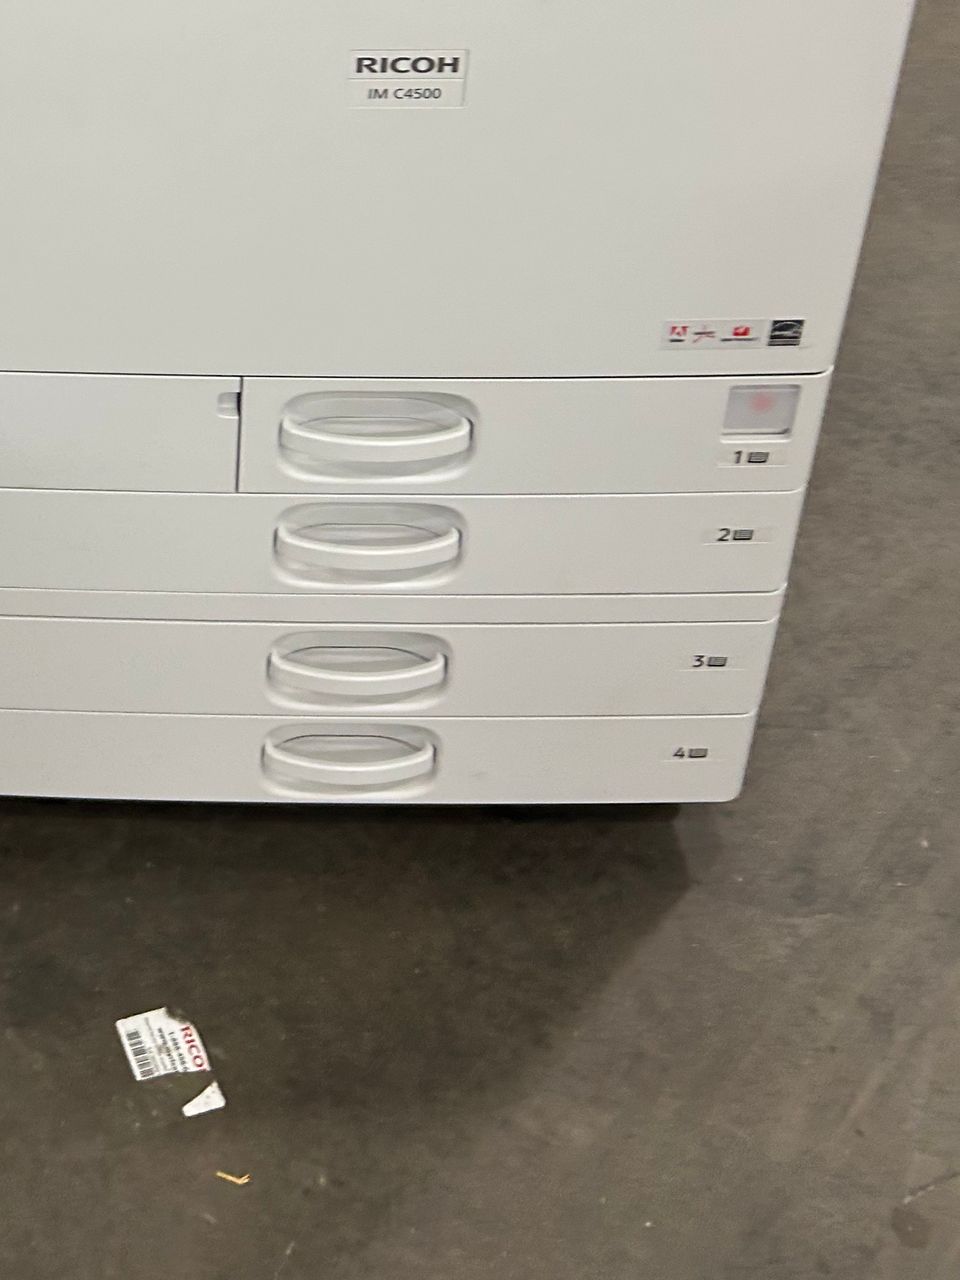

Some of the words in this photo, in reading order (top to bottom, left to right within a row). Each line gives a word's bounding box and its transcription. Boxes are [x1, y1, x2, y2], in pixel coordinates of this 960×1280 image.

[356, 56, 460, 73] RICOH
[367, 88, 389, 100] IM
[393, 88, 442, 100] C4500
[734, 450, 743, 464] 1
[716, 527, 731, 542] 2
[692, 655, 705, 668] 3
[672, 747, 685, 759] 4
